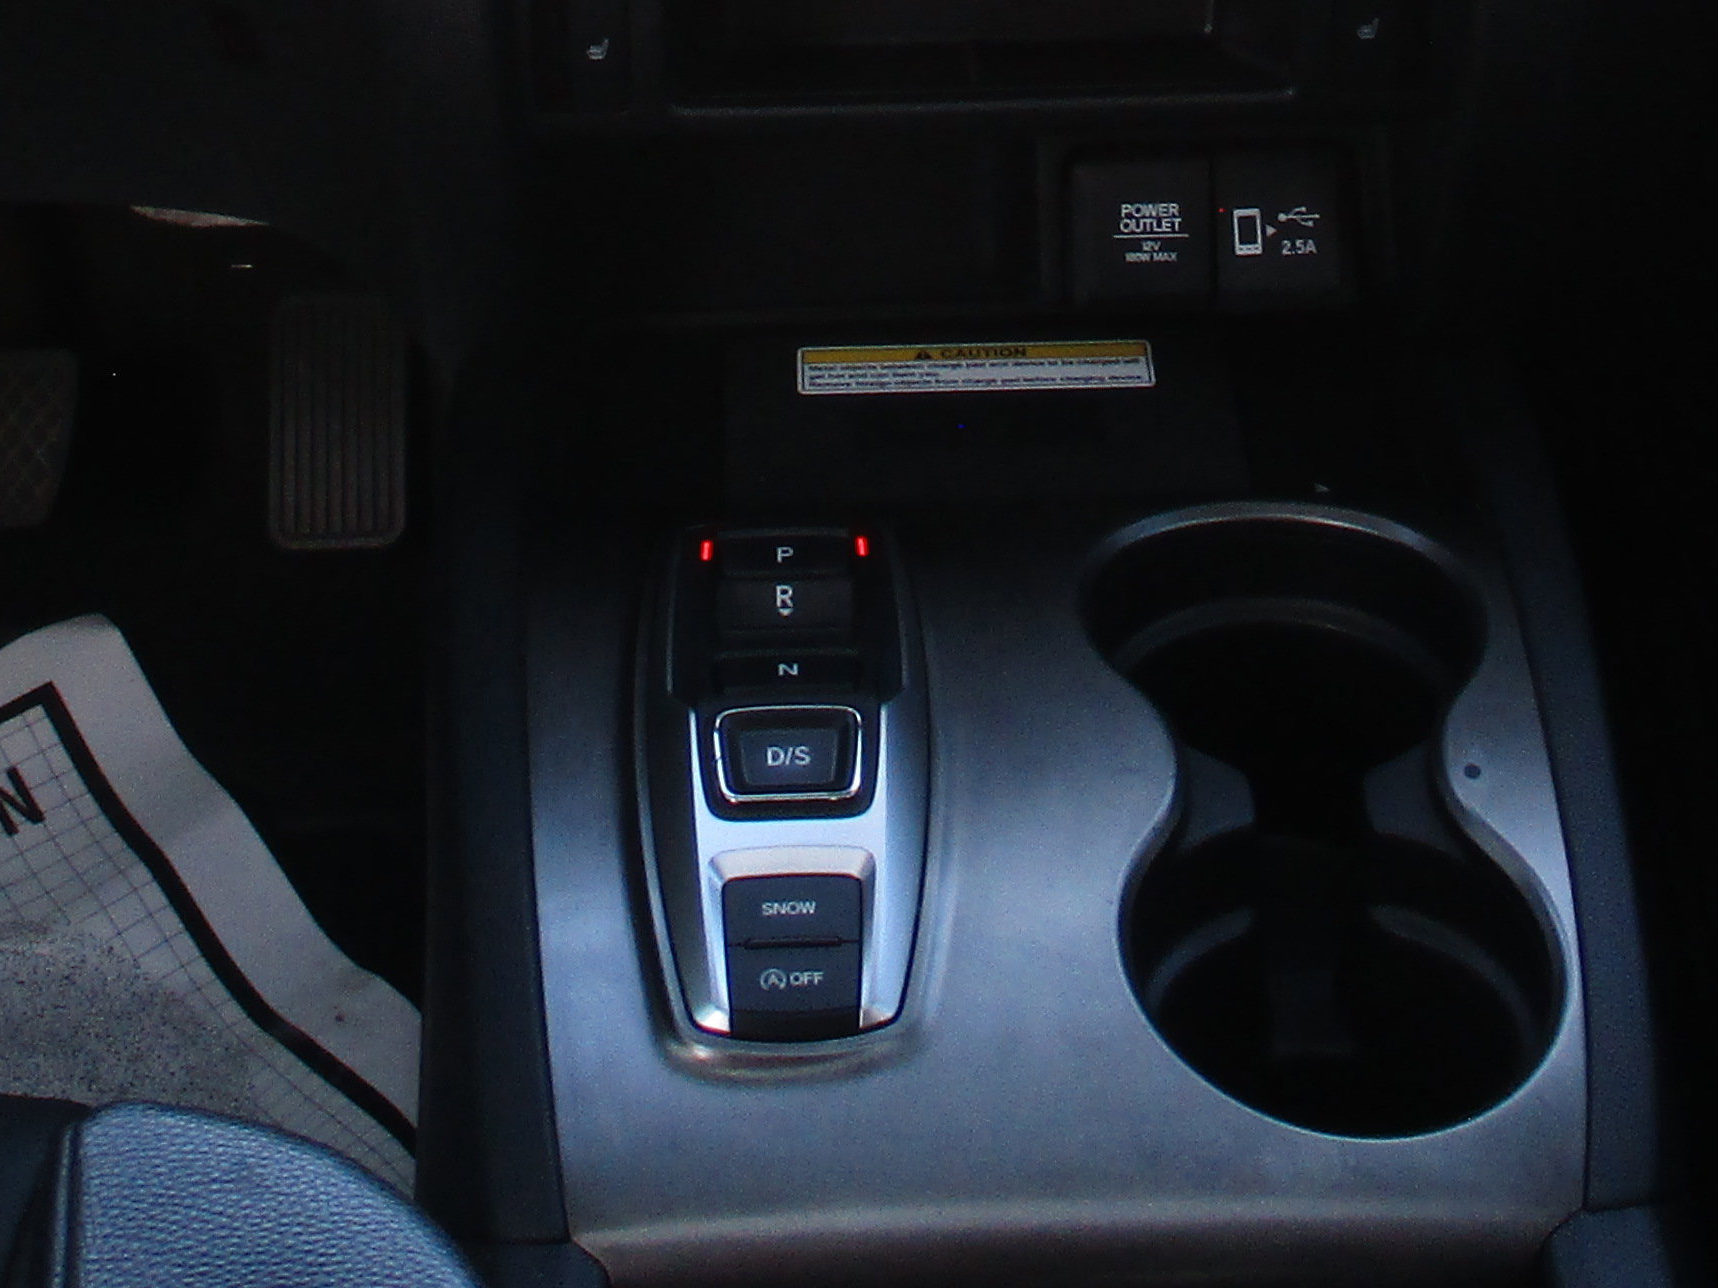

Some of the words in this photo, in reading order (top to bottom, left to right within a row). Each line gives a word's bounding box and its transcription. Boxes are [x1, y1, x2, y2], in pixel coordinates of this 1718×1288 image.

[1121, 203, 1180, 218] POWER
[1119, 218, 1182, 233] OUTLET
[1281, 239, 1318, 255] 2.5A
[939, 346, 1027, 361] CAUTION
[776, 546, 794, 564] P
[775, 584, 794, 608] R
[778, 662, 799, 676] N
[766, 745, 812, 767] D/S
[761, 900, 817, 916] SNOW
[789, 971, 824, 986] OFF
